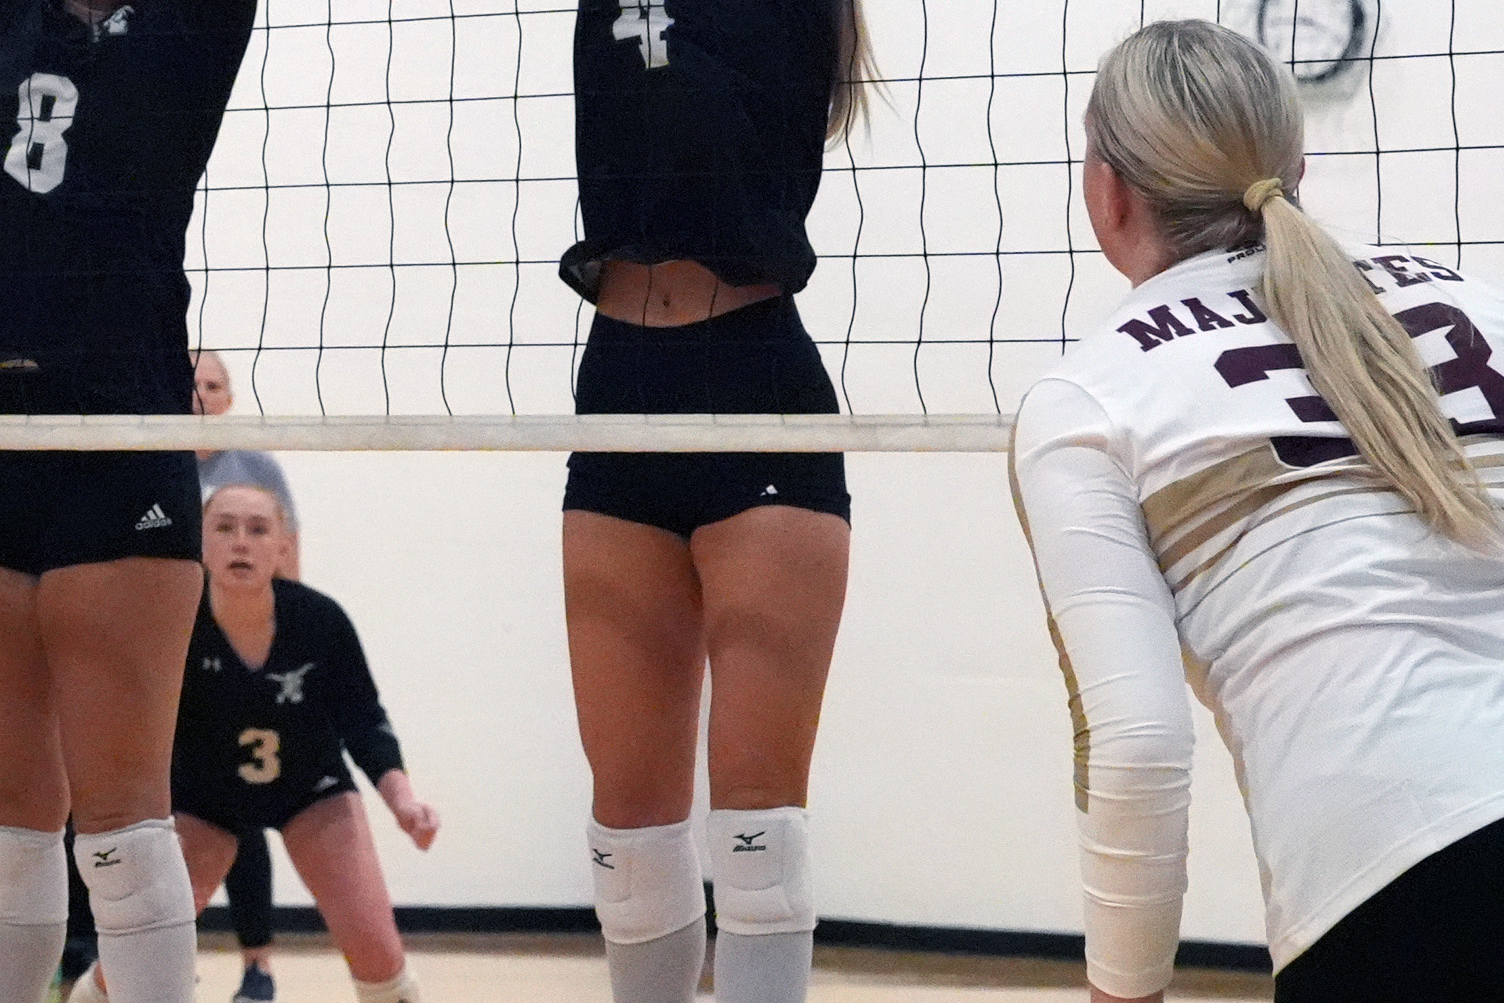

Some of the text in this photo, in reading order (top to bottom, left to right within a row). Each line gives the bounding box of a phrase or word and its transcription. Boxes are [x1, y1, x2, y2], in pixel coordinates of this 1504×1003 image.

[3, 72, 79, 194] 8
[1227, 243, 1266, 264] PROL
[1116, 254, 1465, 353] MAJTES
[237, 728, 281, 784] 3
